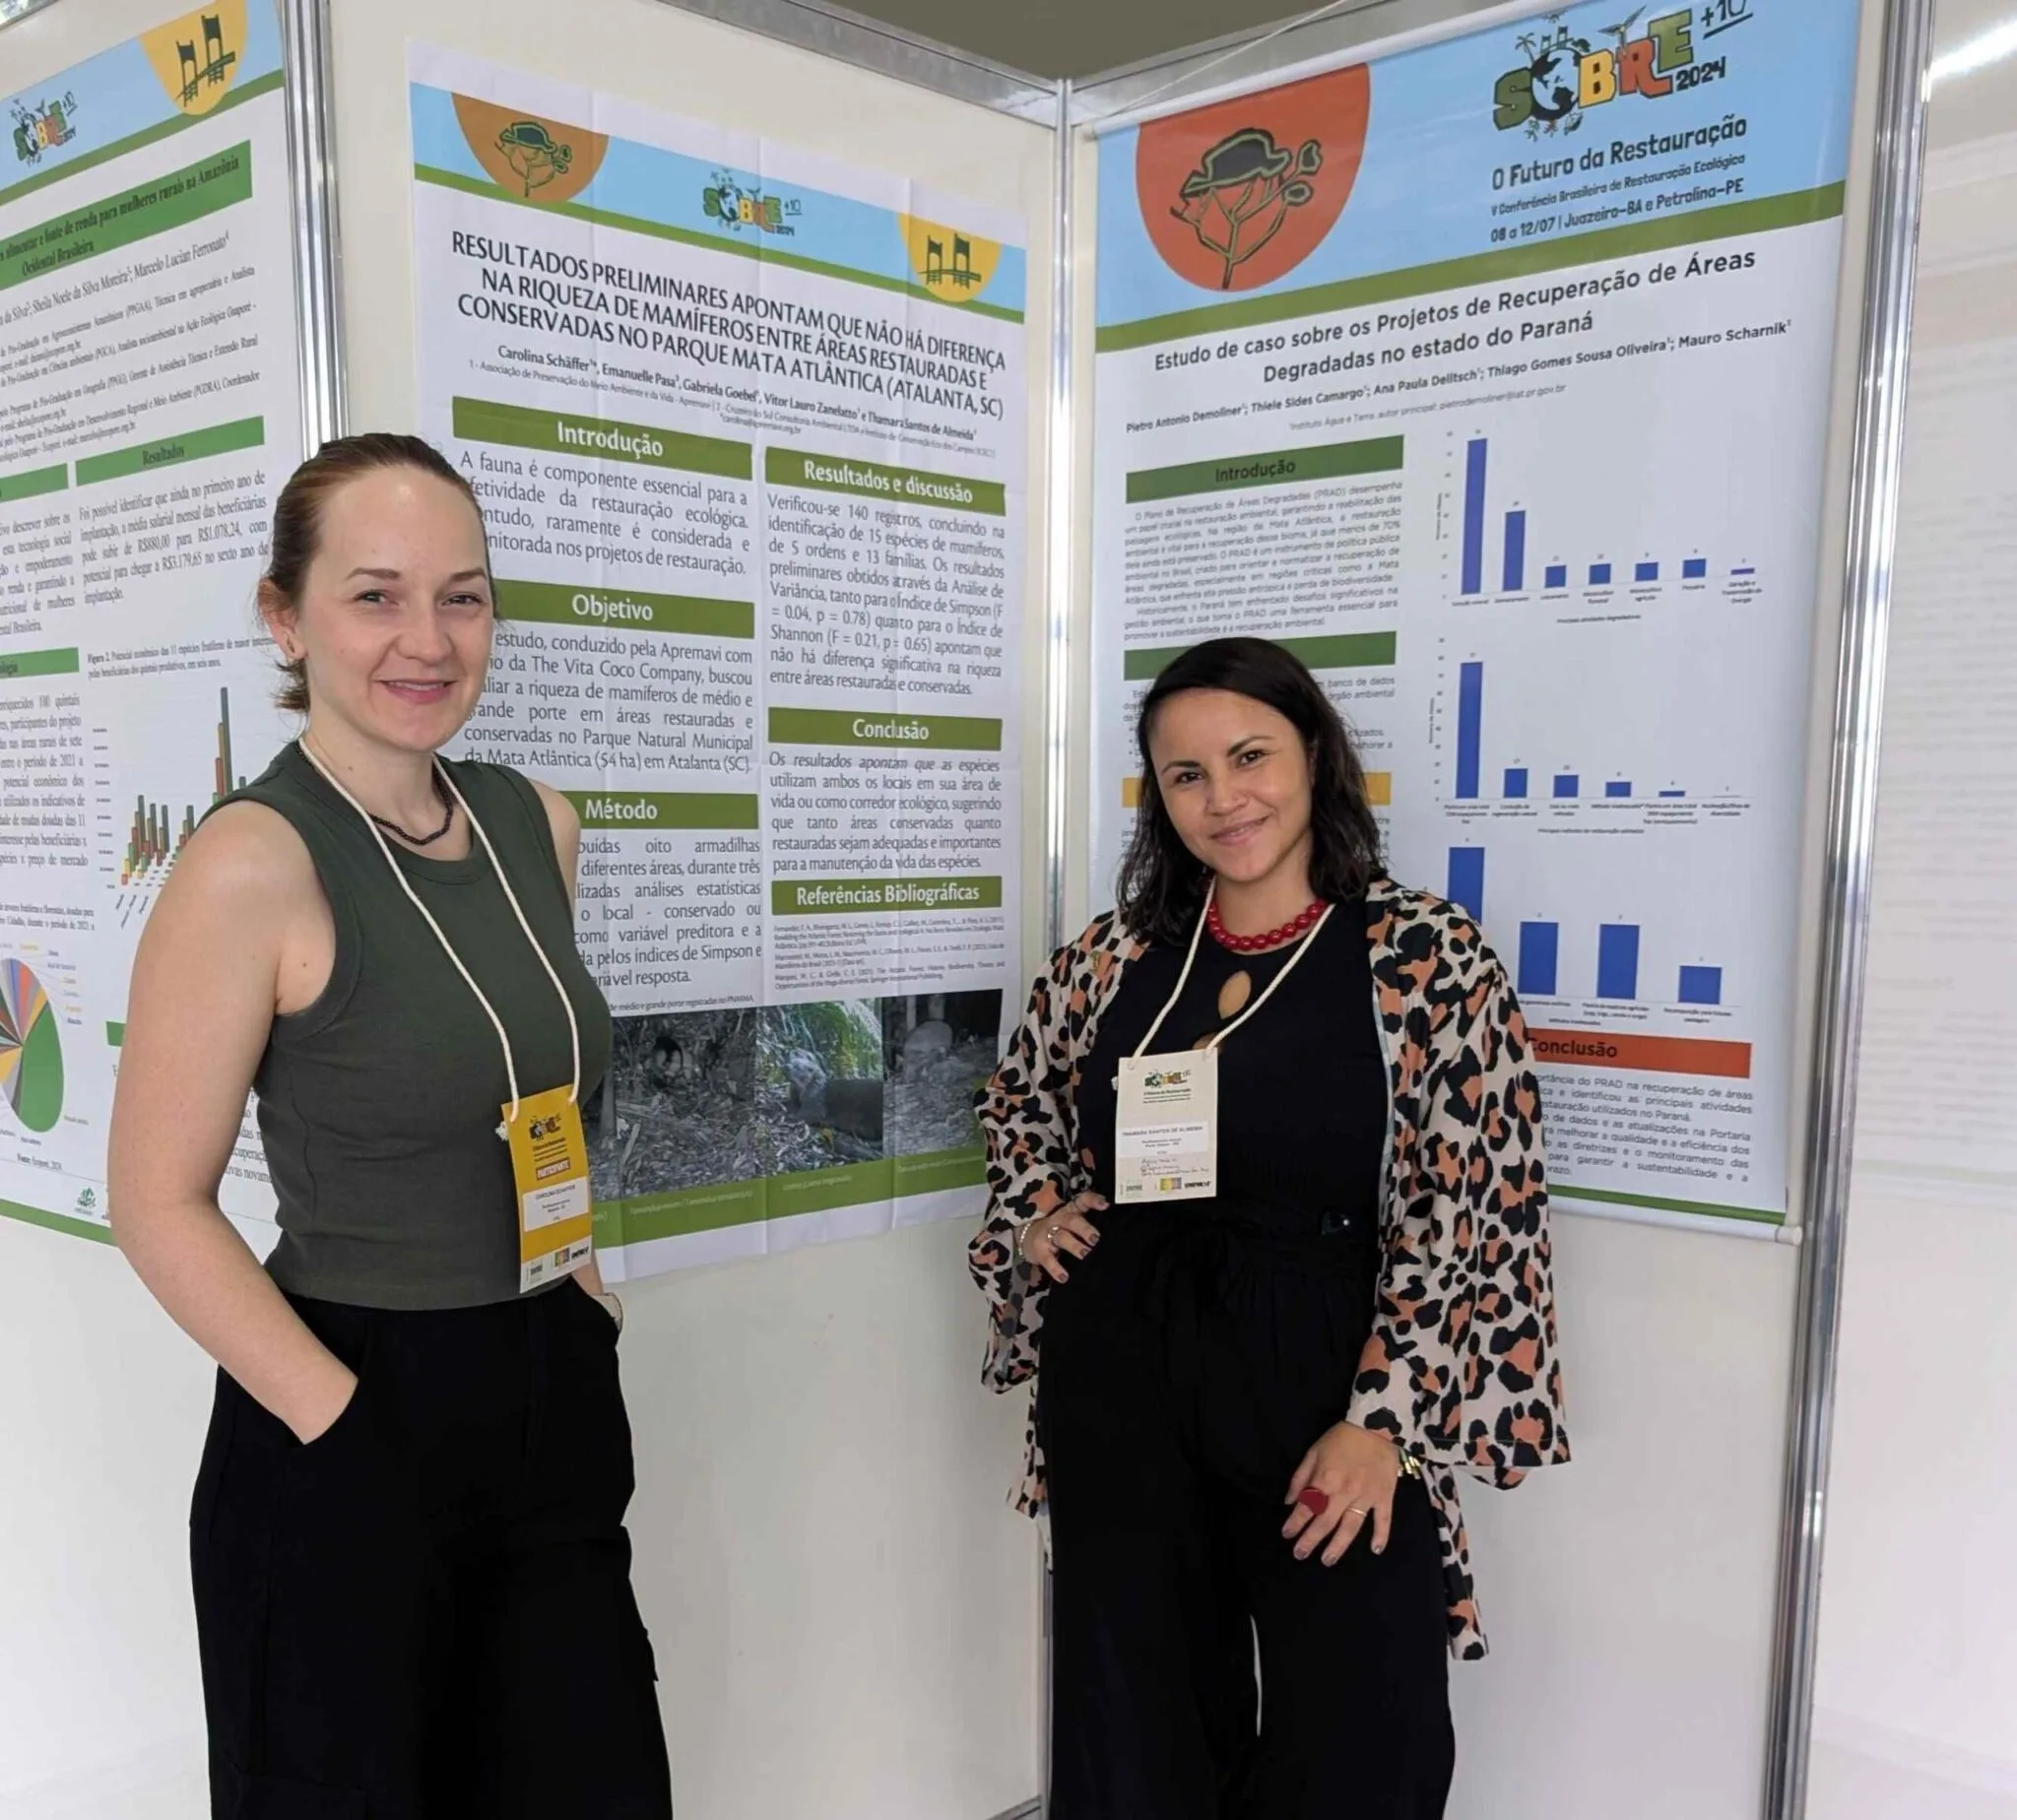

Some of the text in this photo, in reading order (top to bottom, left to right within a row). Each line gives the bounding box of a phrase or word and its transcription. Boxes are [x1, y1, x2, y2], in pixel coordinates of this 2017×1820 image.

[1676, 55, 1726, 93] 2024
[1492, 114, 1746, 190] O Futuro da Restauração
[1491, 154, 1745, 216] V Conferência Brasileira de Restauração Ecológica
[1490, 177, 1743, 242] 08 a 12/07 Juazeiro-BA e Petrolina-PE
[453, 231, 1005, 372] RESULTADOS PRELIMINARES APONTAM QUE NÃO HÁ DIFERENÇA
[1154, 252, 1755, 370] Estudo de caso sobre os Projetos de Recuperação de Áreas
[483, 268, 986, 390] NA RIQUEZA DE MAMÍFEROS ENTRE ÁREAS RESTAURADAS E
[1264, 310, 1593, 382] Degradadas no estado do Paraná
[458, 293, 1003, 421] CONSERVADAS NO PARQUE MATA ATLÂNTICA (ATALANTA, SC)
[1126, 422, 1153, 432] Pietro
[1155, 415, 1190, 427] Antonio
[1251, 400, 1282, 412] Thiele
[1284, 396, 1313, 408] Sides
[1373, 384, 1395, 395] Ana
[1398, 377, 1428, 391] Paula
[1487, 363, 1528, 376] Thiago
[1530, 356, 1572, 370] Gomes
[1575, 350, 1612, 363] Sousa
[1677, 334, 1722, 348] Mauro
[142, 444, 184, 465] Resultados
[557, 422, 663, 458] Introdução
[460, 450, 748, 505] A fauna é componente essencial para a
[804, 460, 972, 502] Resultados e discussão
[1215, 459, 1295, 482] Introdução
[469, 476, 747, 530] fetividade da restauração ecológica.
[480, 506, 749, 552] ntudo, raramente é considerada e
[571, 594, 653, 621] Objetivo
[495, 631, 752, 663] estudo, conduzido pela Apremavi com
[852, 718, 929, 740] Conclusão
[585, 798, 657, 819] Método
[771, 834, 1001, 853] restauradas sejam adequadas e importantes
[797, 882, 979, 906] Referências Bibliográficas
